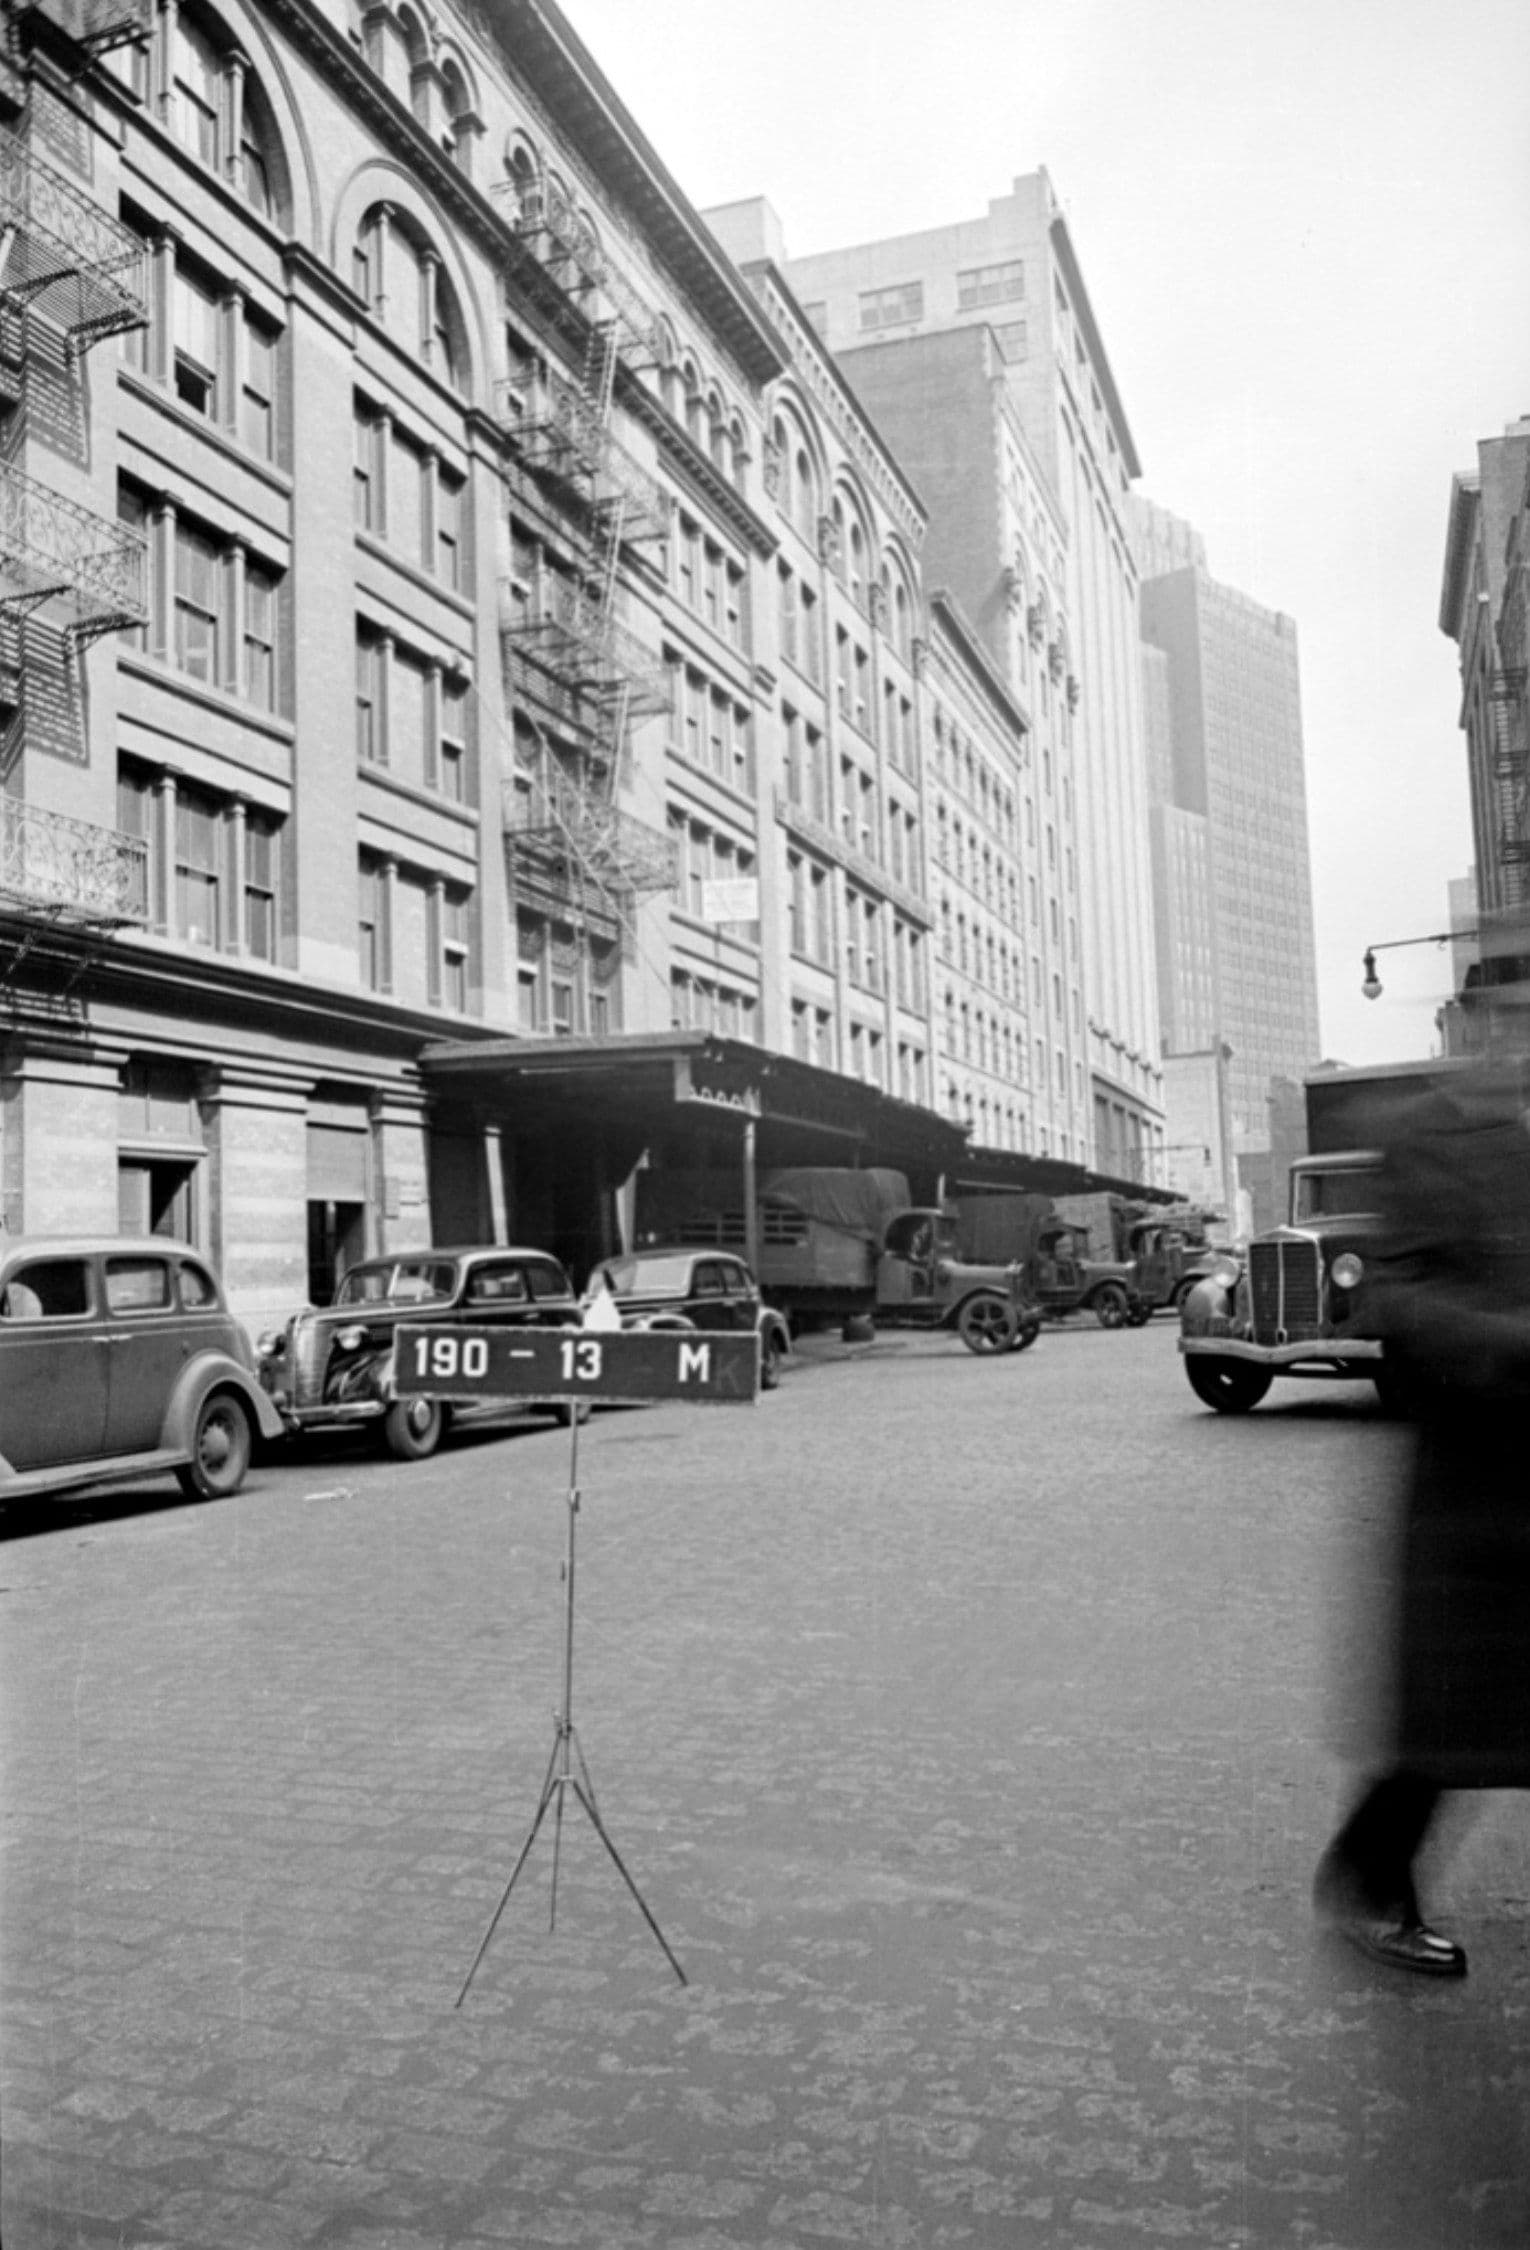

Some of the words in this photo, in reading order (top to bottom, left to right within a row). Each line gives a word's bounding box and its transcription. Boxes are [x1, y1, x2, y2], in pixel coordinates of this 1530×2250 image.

[415, 1336, 488, 1377] 190
[561, 1339, 601, 1380] 13
[678, 1343, 710, 1382] M
